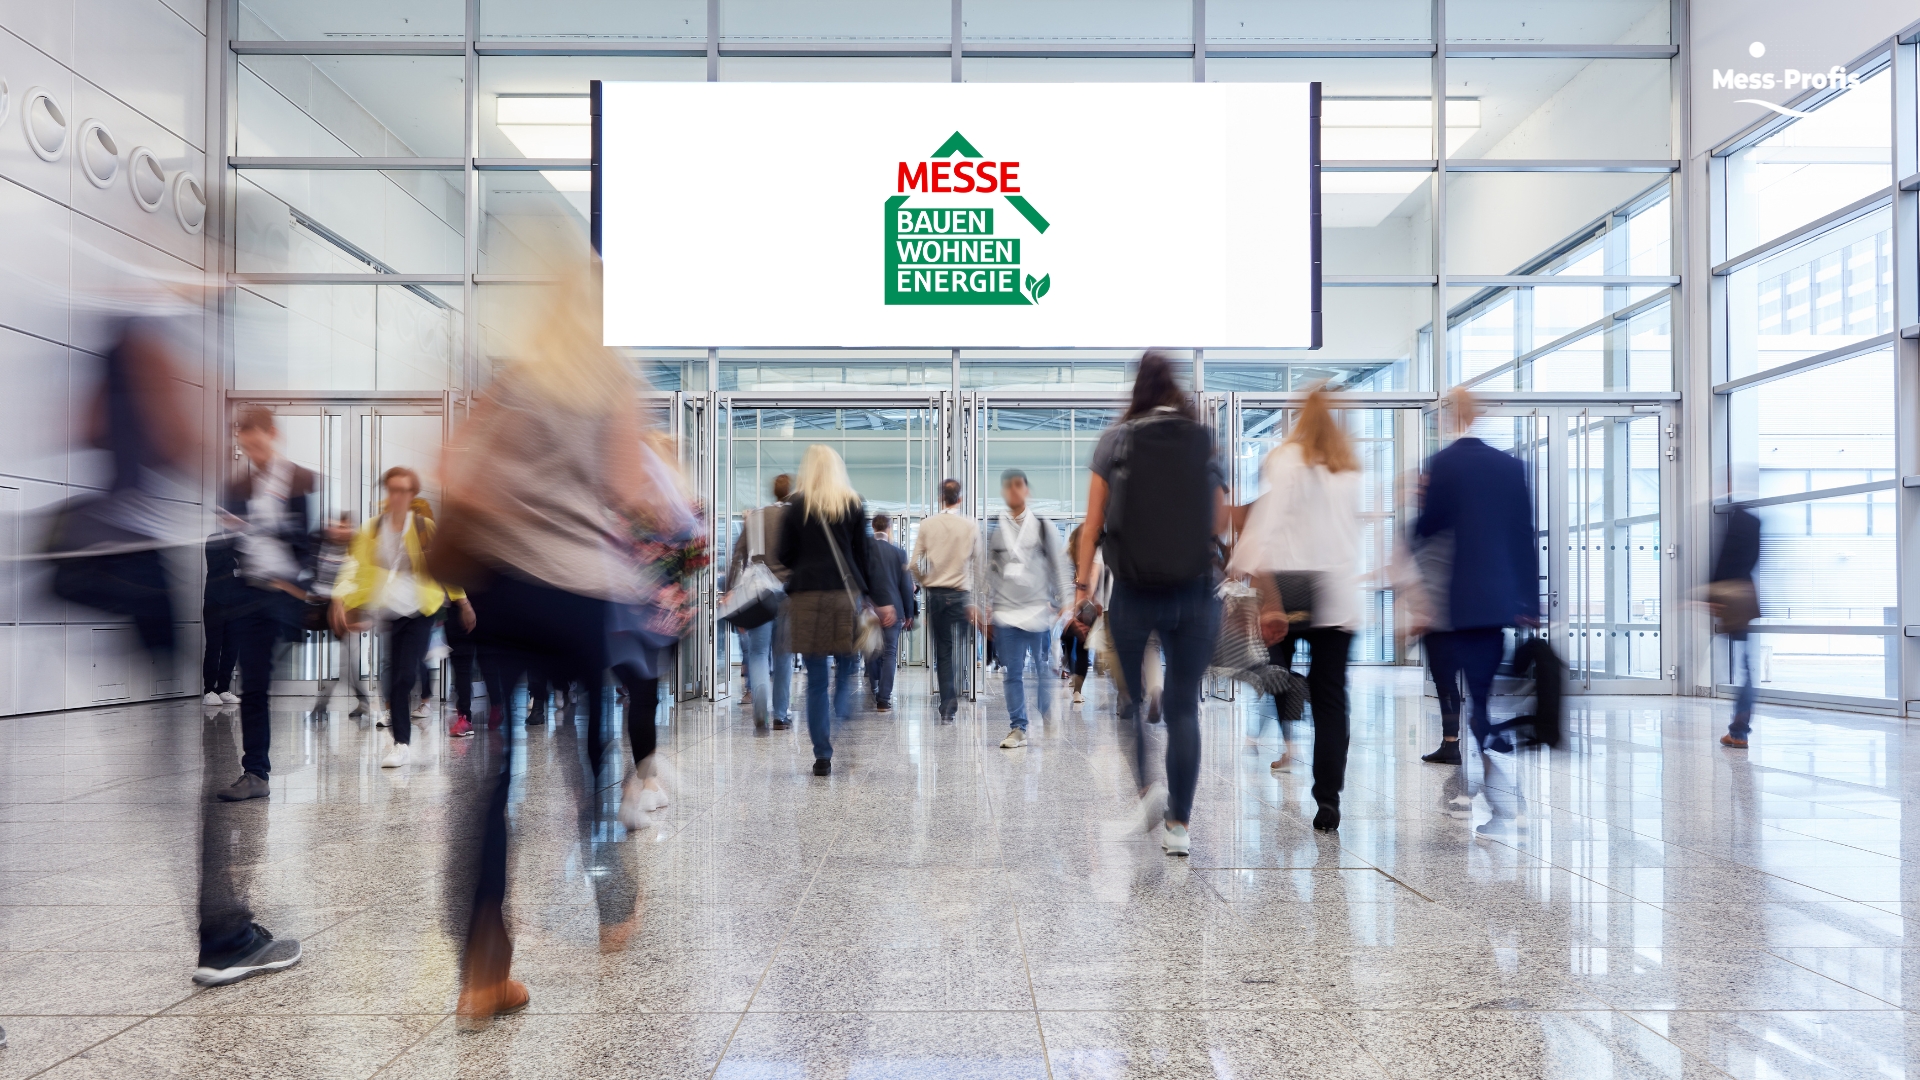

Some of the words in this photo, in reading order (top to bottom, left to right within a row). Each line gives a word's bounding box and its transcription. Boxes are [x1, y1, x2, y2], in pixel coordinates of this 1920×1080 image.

[897, 161, 1021, 193] MESSE
[897, 210, 986, 233] BAUEN
[896, 240, 1013, 263] WOHNEN
[897, 270, 1013, 293] ENERGIE
